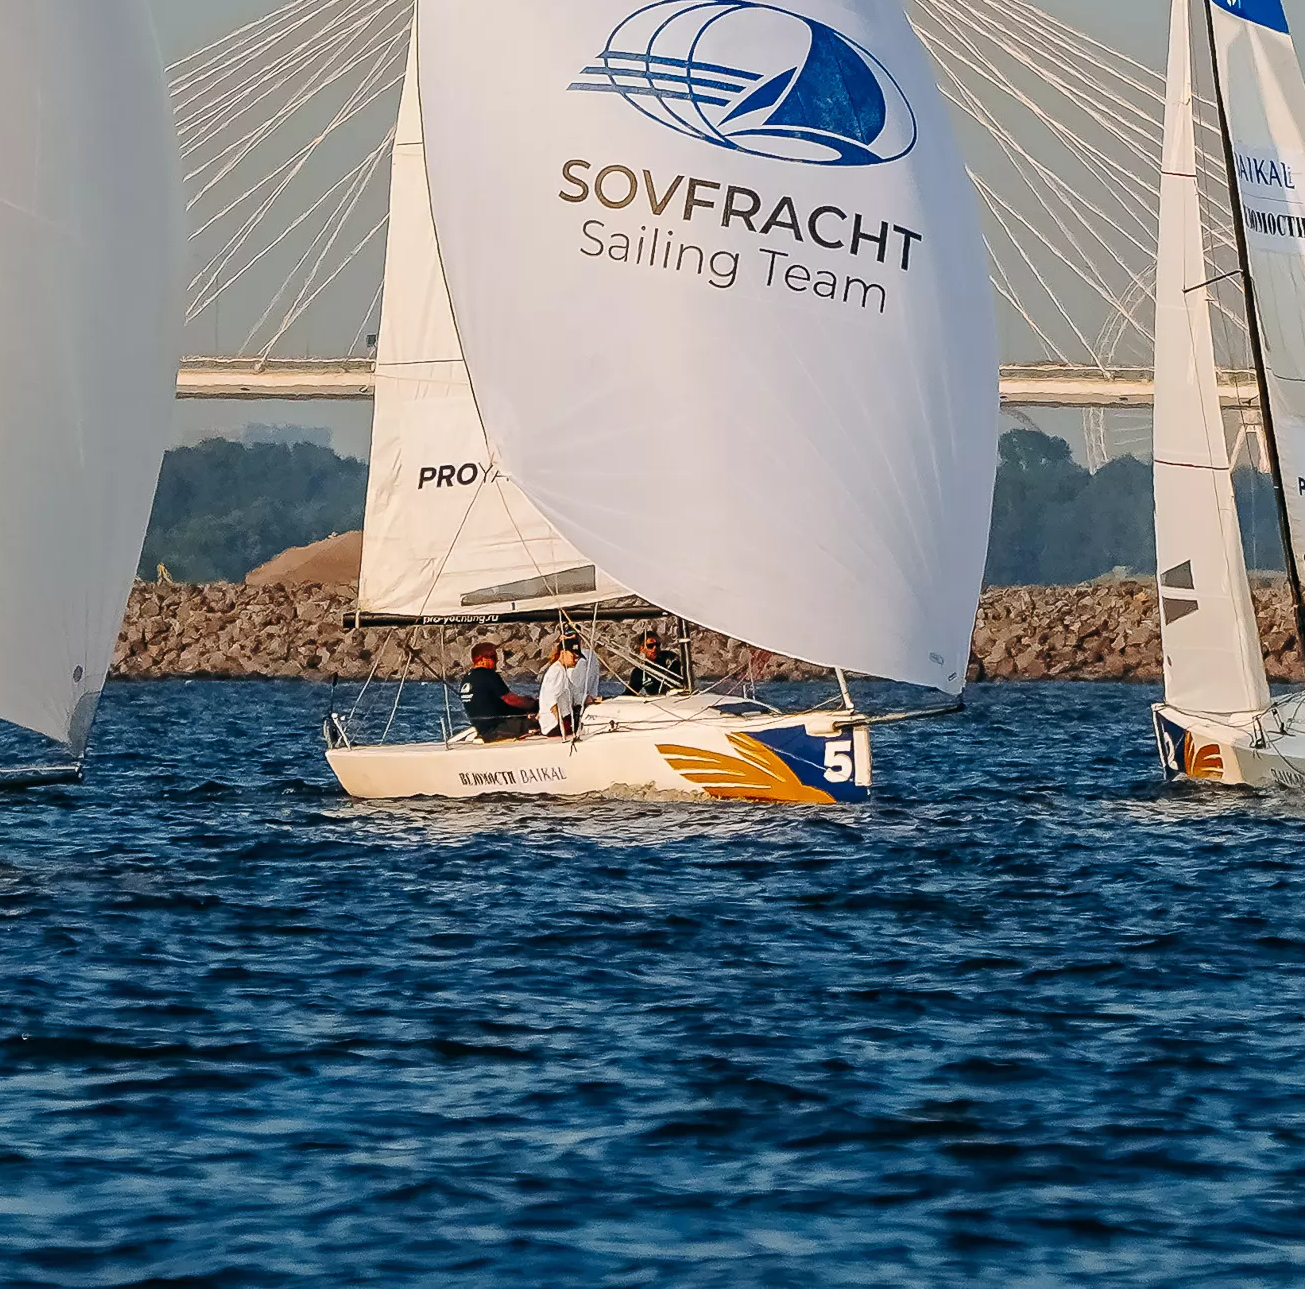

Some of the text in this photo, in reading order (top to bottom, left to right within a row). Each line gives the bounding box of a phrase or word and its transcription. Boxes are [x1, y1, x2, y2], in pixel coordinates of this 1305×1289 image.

[558, 158, 923, 271] SOVFRACHT
[579, 219, 887, 314] Sailing Team
[519, 767, 568, 784] BAIKAL
[823, 739, 853, 783] 5
